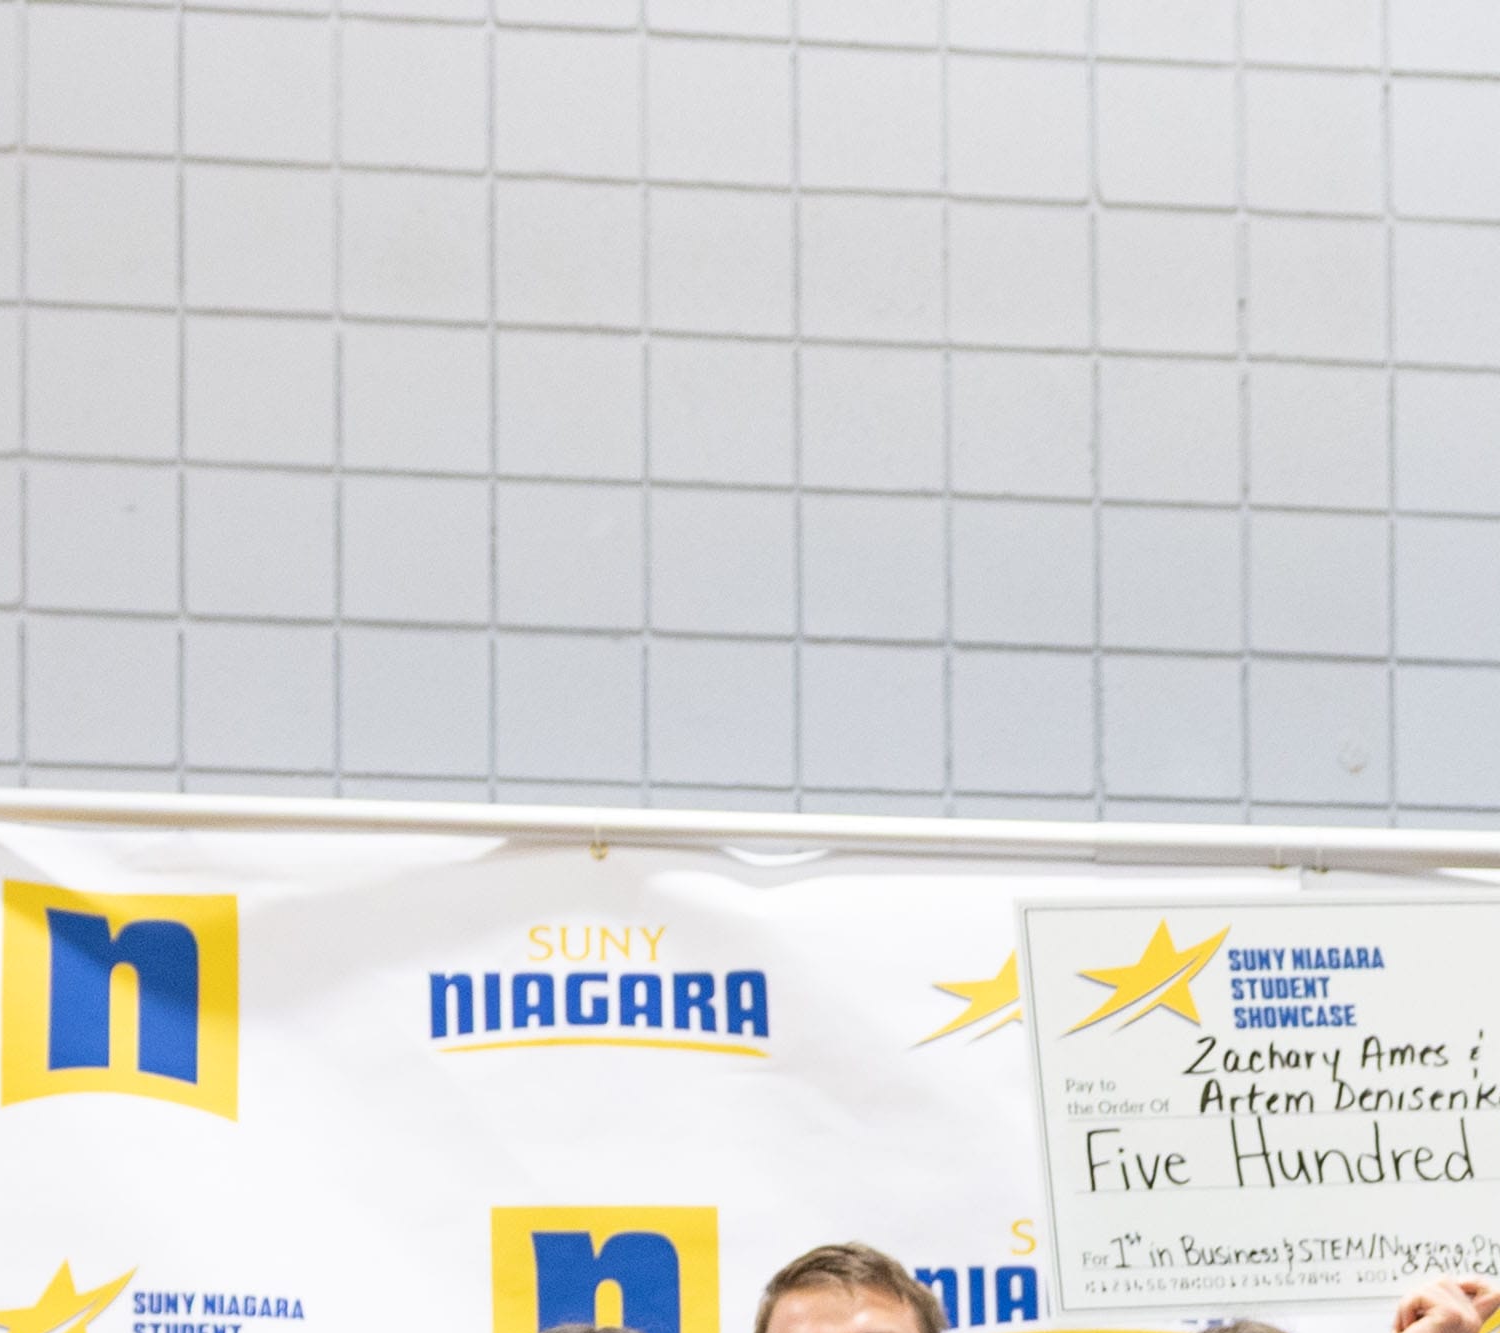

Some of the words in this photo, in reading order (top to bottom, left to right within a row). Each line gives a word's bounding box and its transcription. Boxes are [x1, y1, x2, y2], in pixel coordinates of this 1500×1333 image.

[528, 926, 666, 961] SUNY
[1229, 949, 1284, 971] SUNY
[1293, 948, 1384, 970] NIAGARA
[429, 969, 769, 1040] NIAGARA
[1231, 977, 1330, 999] STUDENT
[1234, 1005, 1356, 1028] SHOWCASE
[1184, 1037, 1339, 1081] Zachary
[1361, 1037, 1448, 1067] Ames
[1201, 1080, 1314, 1113] Artem
[1088, 1129, 1191, 1191] Five
[1230, 1117, 1474, 1188] Hundred
[134, 1293, 196, 1317] SUNY
[201, 1293, 304, 1319] NIAGARA
